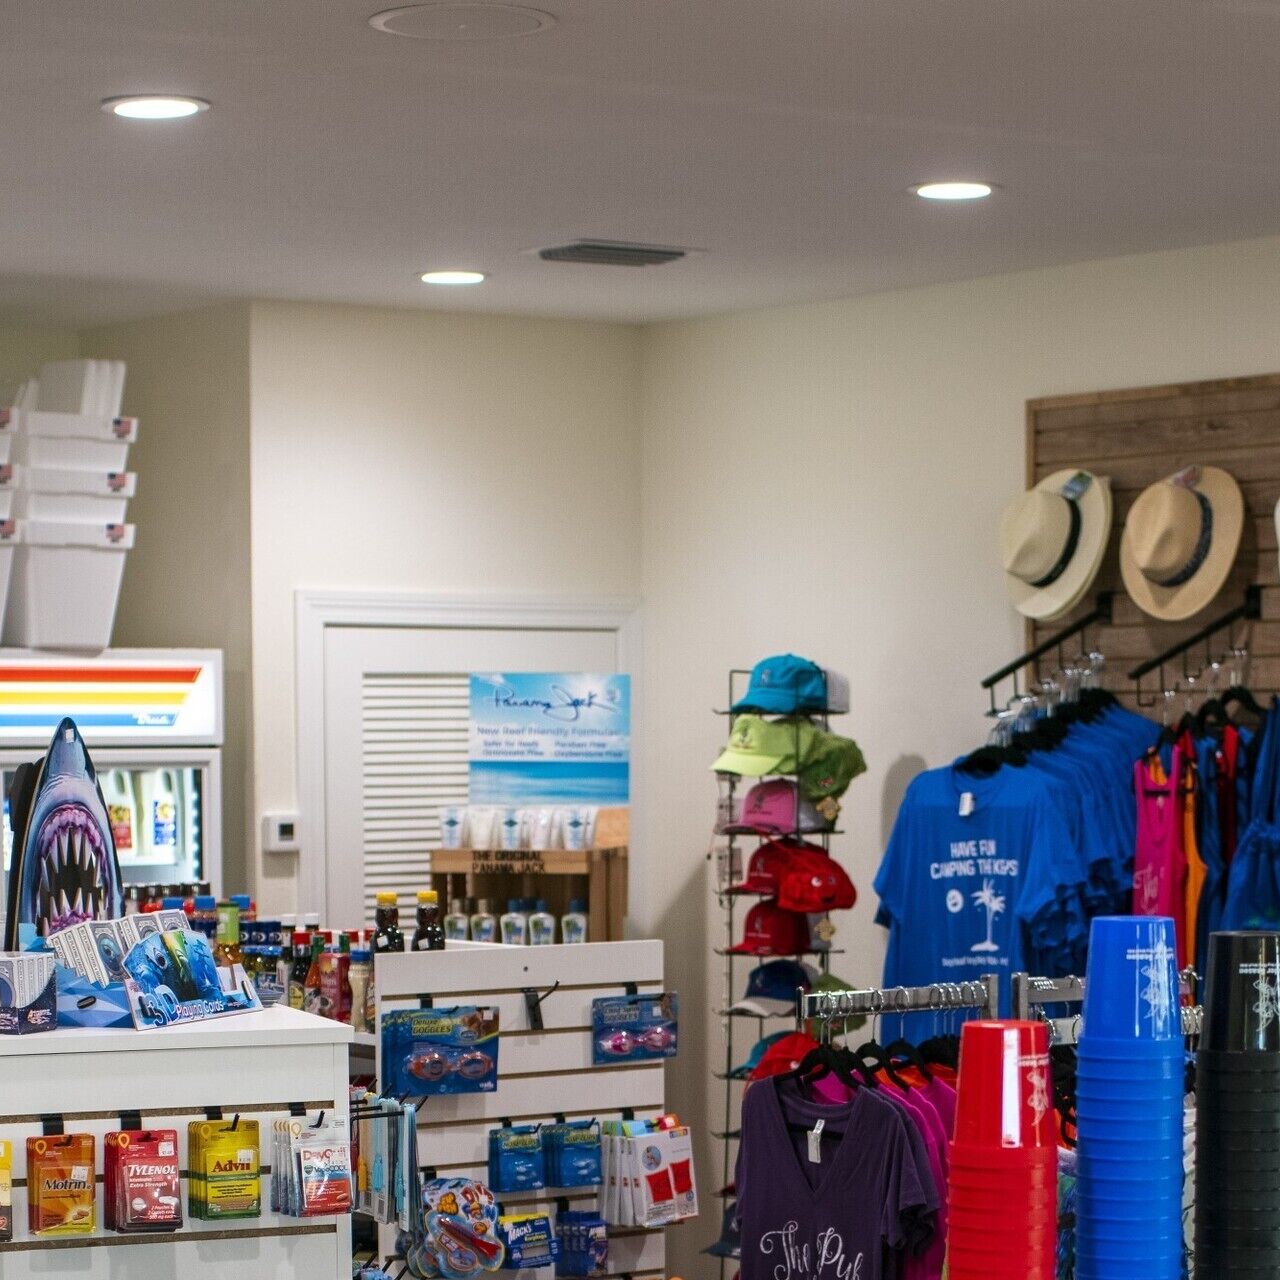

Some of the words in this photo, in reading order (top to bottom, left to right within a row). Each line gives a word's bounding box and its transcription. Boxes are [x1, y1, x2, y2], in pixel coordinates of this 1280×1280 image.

[950, 840, 977, 858] HAVE
[517, 861, 546, 874] JACK
[176, 1002, 204, 1019] Playing
[204, 999, 225, 1013] Cards
[128, 1164, 177, 1176] TYLENOL
[43, 1178, 87, 1191] Motrin
